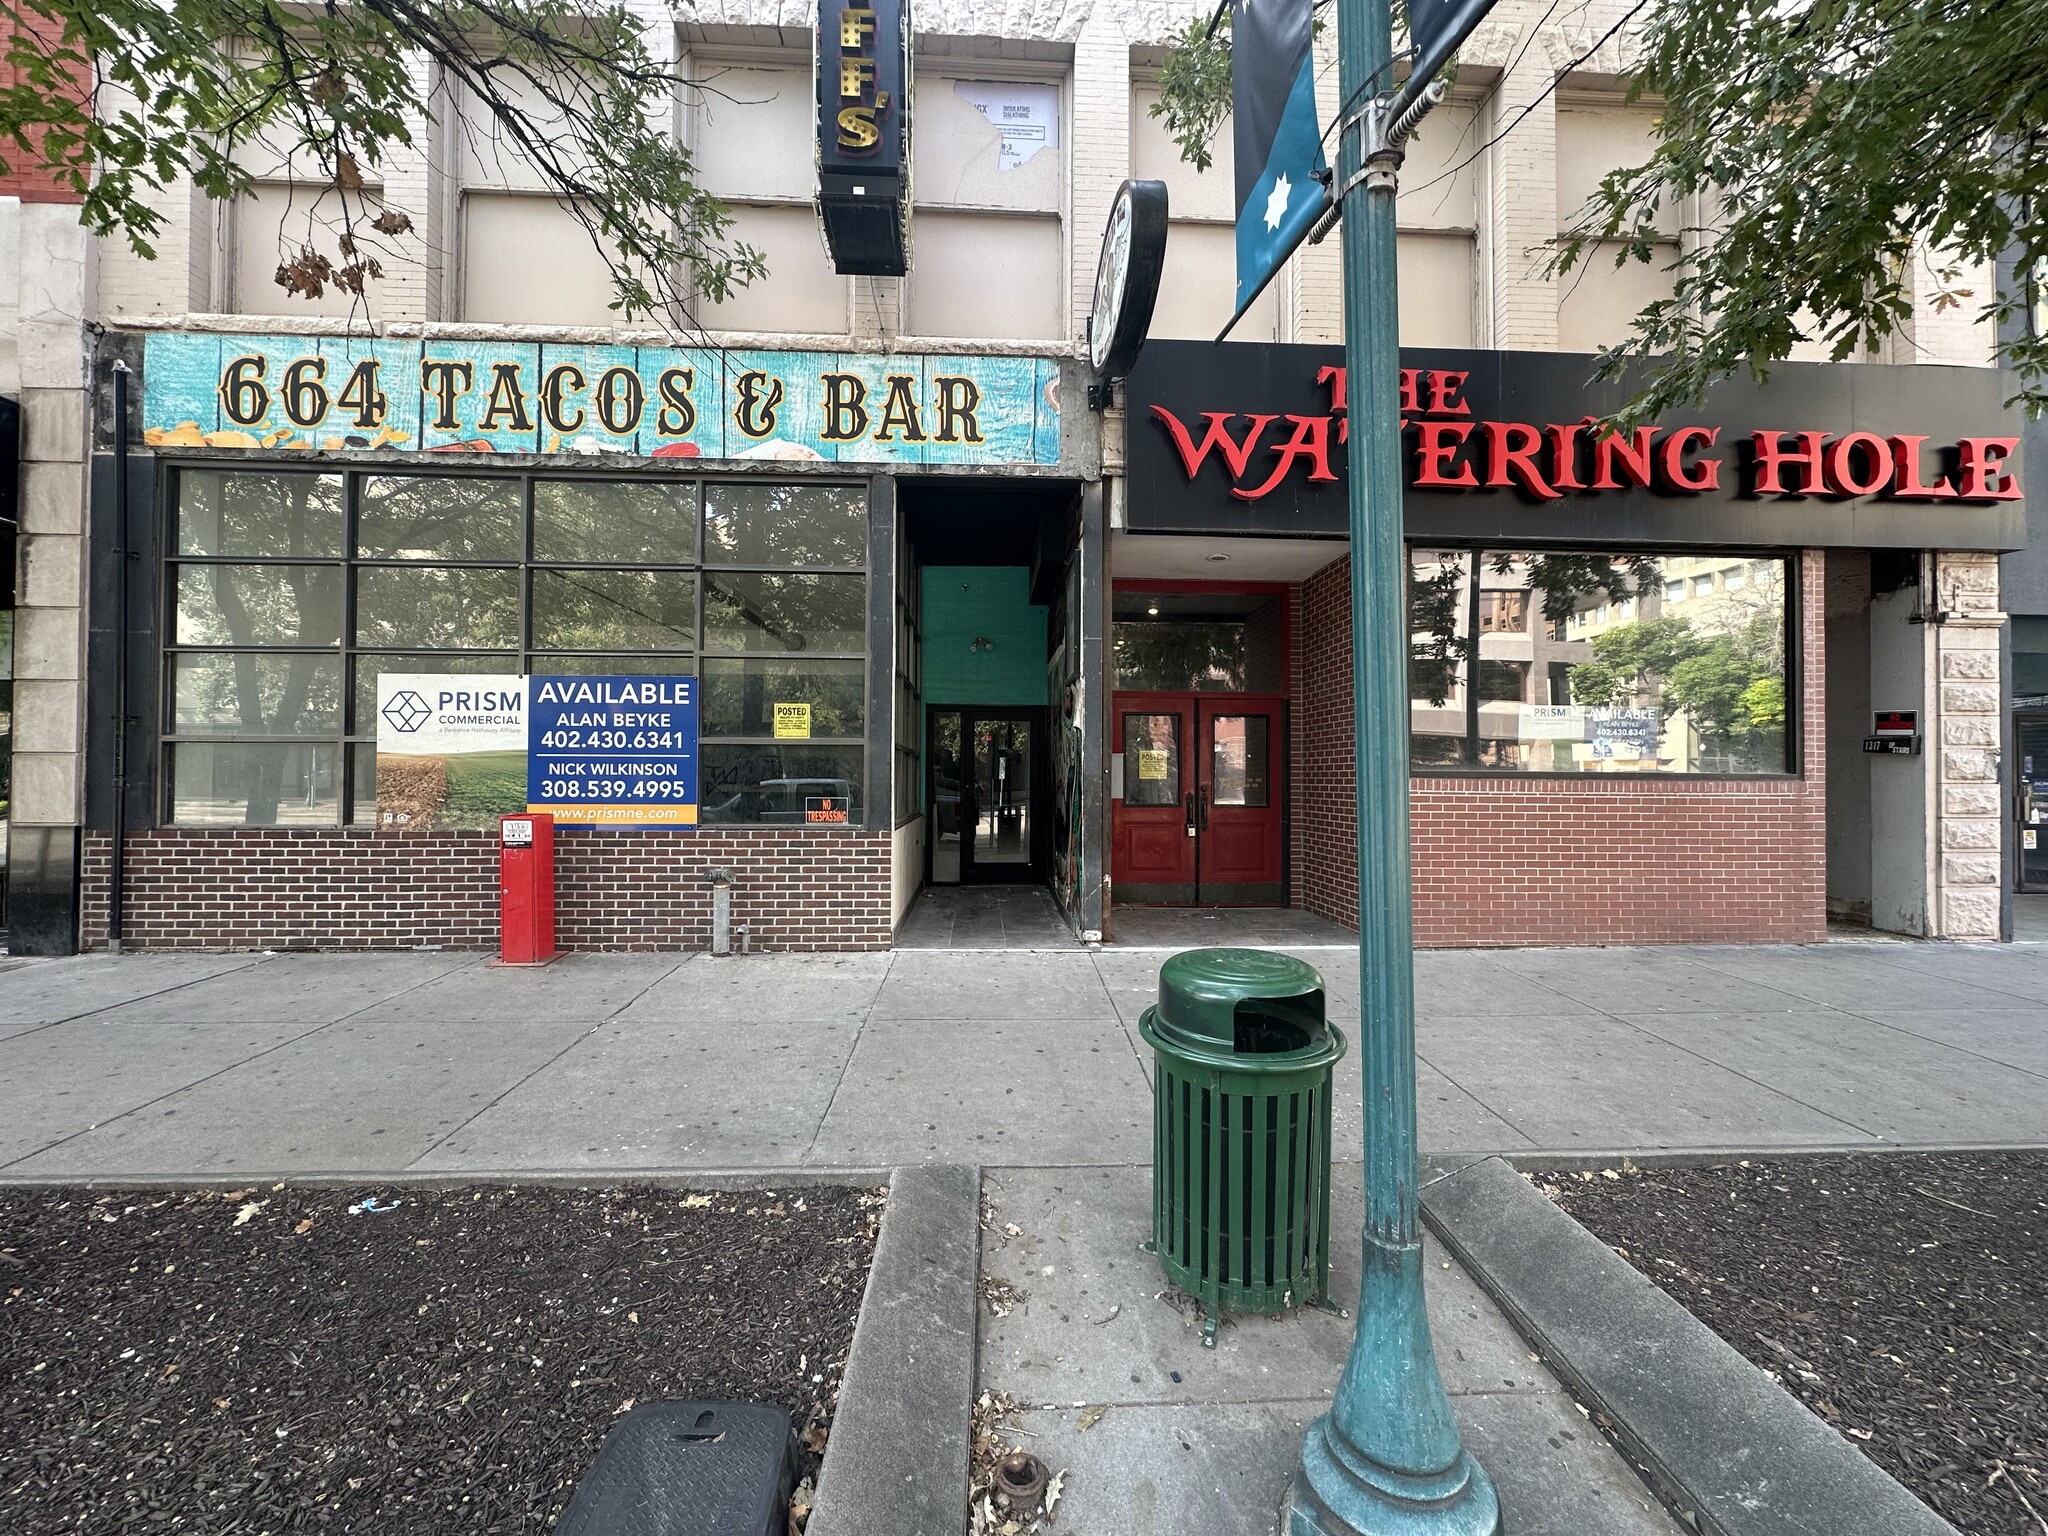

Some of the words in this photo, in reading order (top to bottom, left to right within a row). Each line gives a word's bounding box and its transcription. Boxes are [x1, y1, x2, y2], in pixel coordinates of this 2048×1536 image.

[838, 0, 891, 153] FF'S
[974, 104, 987, 113] GX
[219, 353, 387, 430] 664
[420, 358, 696, 438] TACOS
[735, 369, 784, 439] &
[820, 371, 986, 445] BAR
[1149, 403, 1722, 501] WAERING
[1751, 429, 2024, 502] HOLE
[537, 683, 690, 704] AVAILABLE
[438, 691, 521, 711] PRISM
[777, 706, 807, 716] POSTED
[1533, 708, 1566, 717] PRISM
[438, 714, 521, 725] COMMERCIAL
[556, 713, 606, 727] ALAN
[613, 713, 671, 727] BEYKE
[471, 727, 498, 735] Hathaway
[541, 730, 684, 750] 402.430.6341
[1865, 741, 1880, 750] 1317
[548, 762, 586, 776] NICK
[590, 763, 678, 776] WILKINSON
[541, 780, 685, 798] 308.539.4995
[822, 799, 832, 809] NO
[549, 807, 678, 821] www.prismne.com
[807, 810, 847, 822] TRESPASSING
